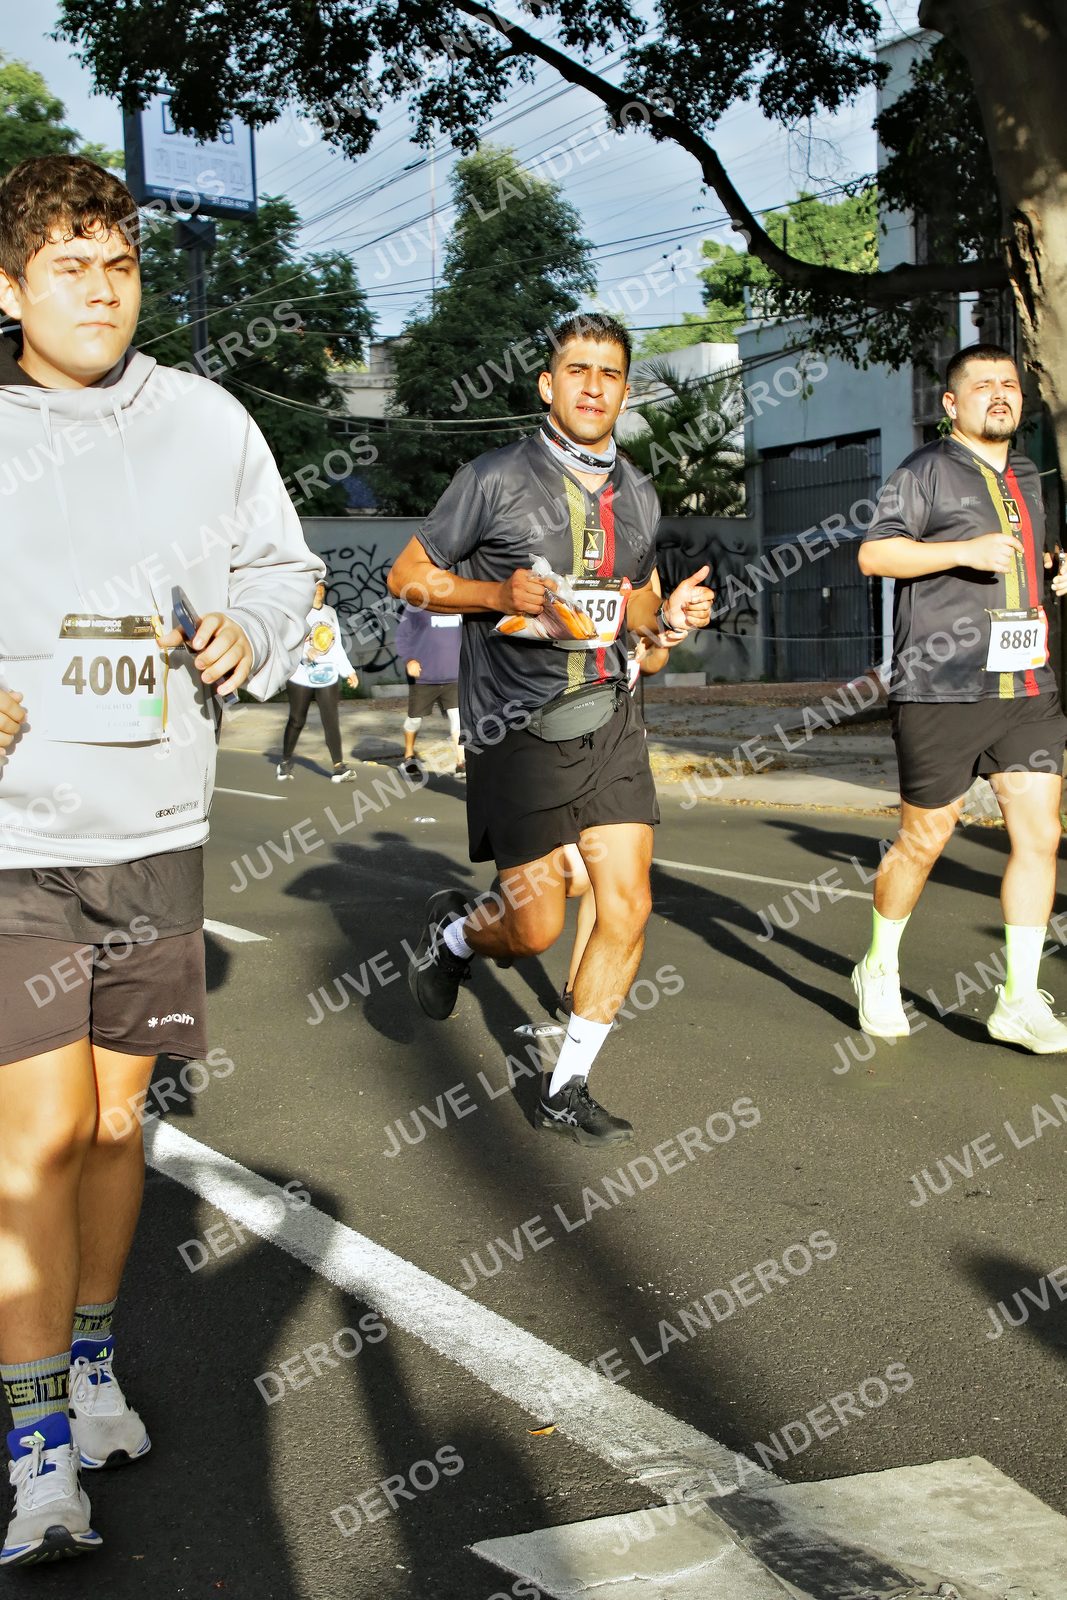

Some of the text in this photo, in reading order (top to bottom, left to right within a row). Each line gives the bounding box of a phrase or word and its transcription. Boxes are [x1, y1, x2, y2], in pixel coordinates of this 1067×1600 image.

[577, 599, 618, 622] 550
[1000, 628, 1039, 650] 8881
[61, 655, 157, 696] 4004
